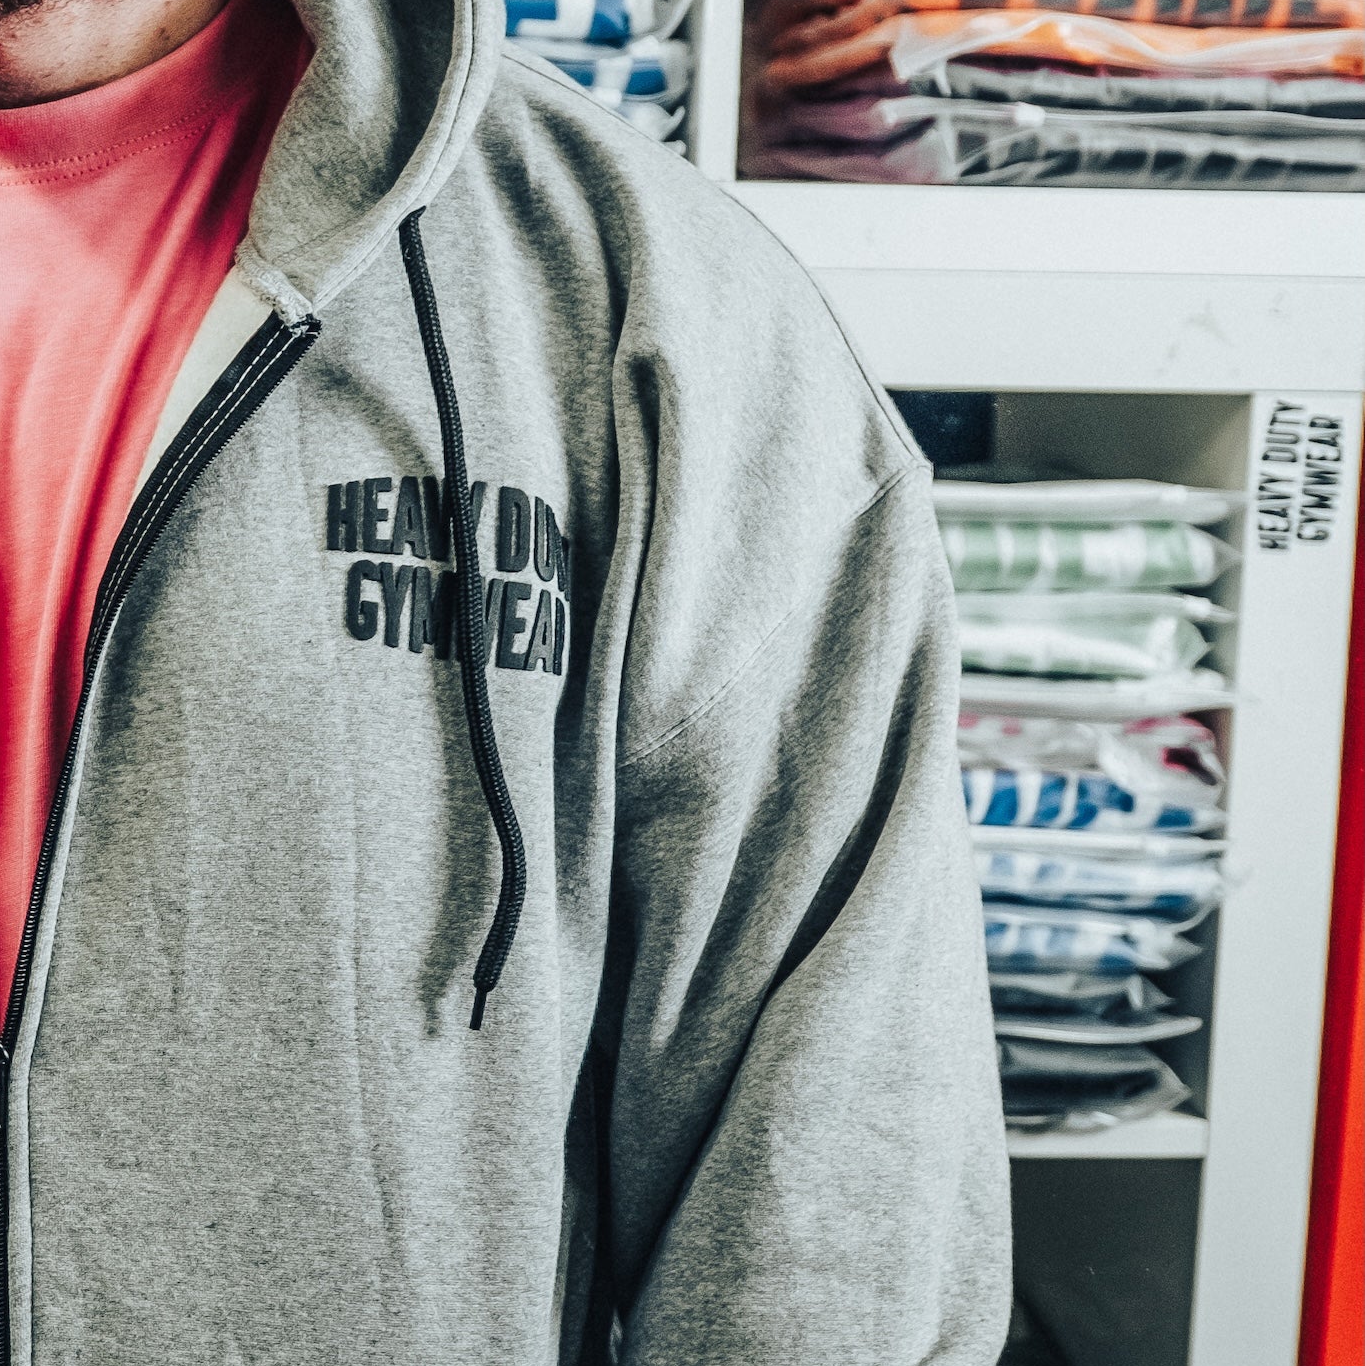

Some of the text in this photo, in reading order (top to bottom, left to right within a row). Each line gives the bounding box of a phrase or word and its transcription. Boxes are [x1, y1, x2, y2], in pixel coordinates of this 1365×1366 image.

[1256, 400, 1303, 551] HEAVY DUTY
[1297, 417, 1341, 540] GYMWEAR
[345, 559, 568, 676] GYMEA
